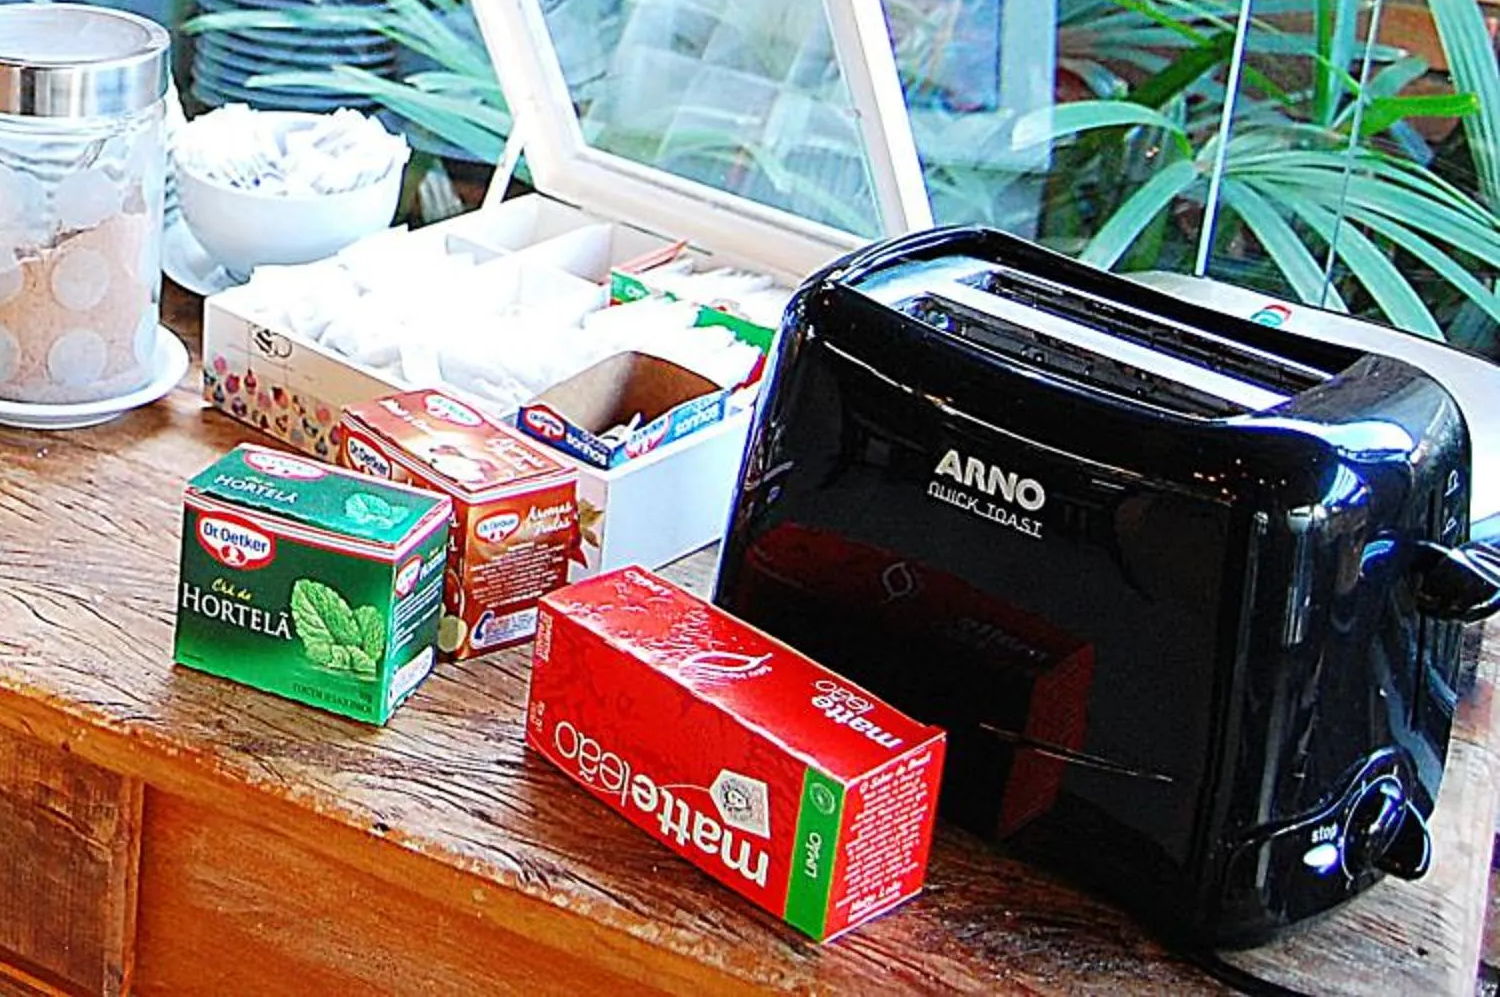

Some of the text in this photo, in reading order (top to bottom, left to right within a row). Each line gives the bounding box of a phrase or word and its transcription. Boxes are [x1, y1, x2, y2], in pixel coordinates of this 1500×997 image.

[213, 474, 298, 504] HORTELÃ
[934, 448, 1046, 512] ARNO
[974, 502, 1043, 540] TOAST
[182, 583, 293, 640] HORTELÃ
[811, 695, 903, 749] matte
